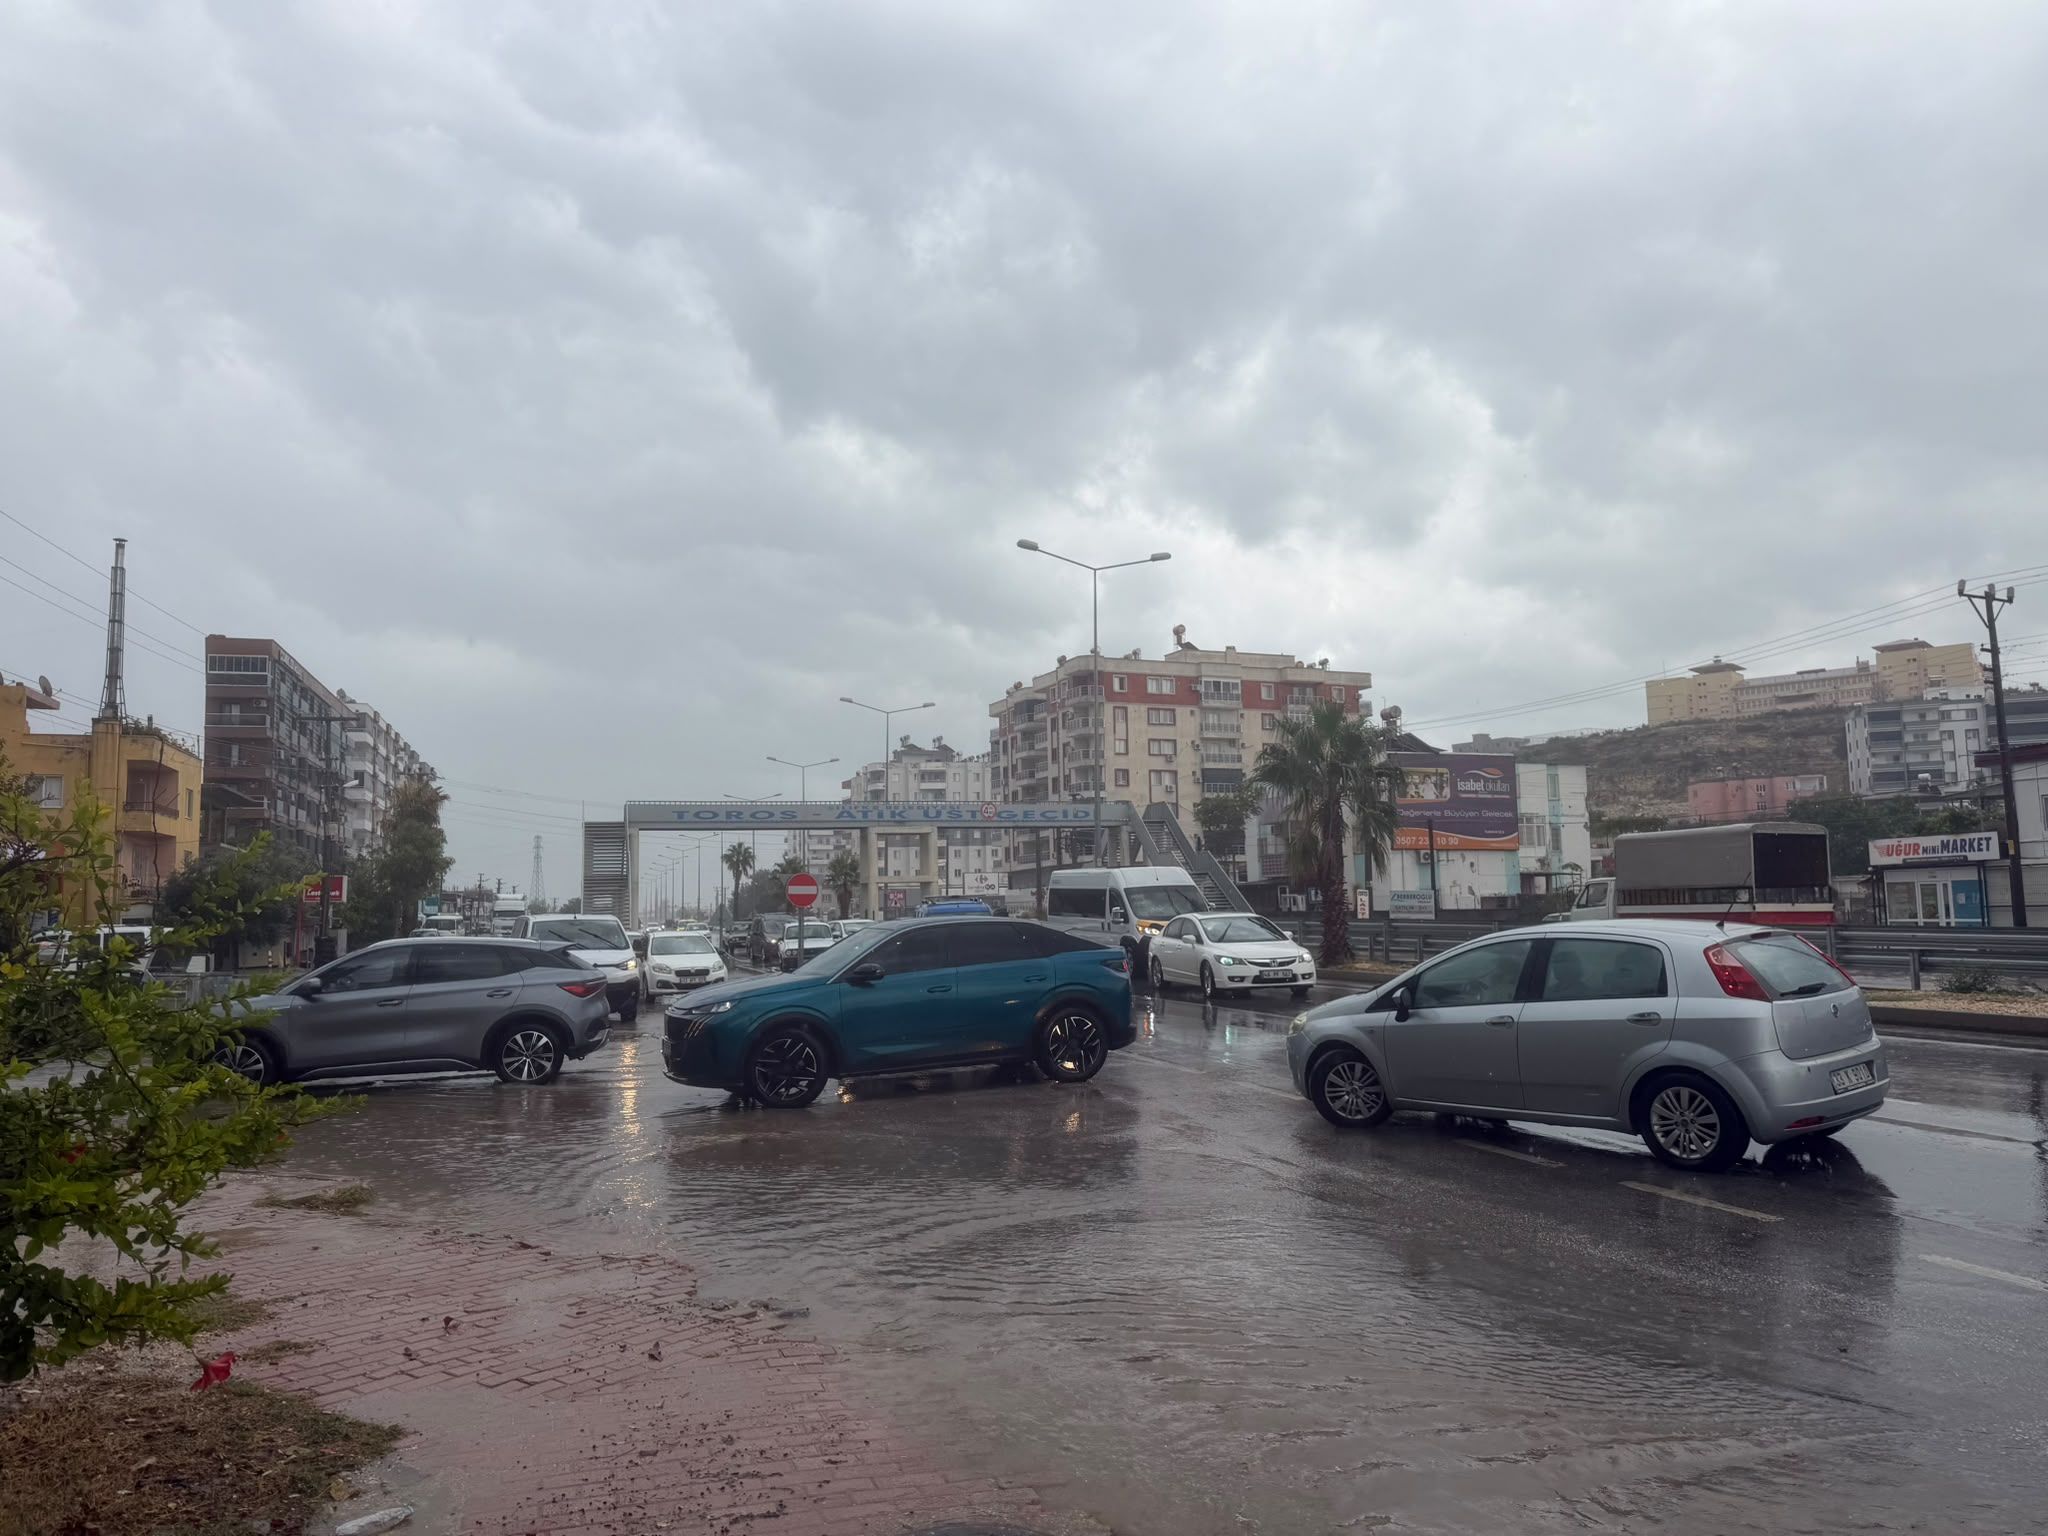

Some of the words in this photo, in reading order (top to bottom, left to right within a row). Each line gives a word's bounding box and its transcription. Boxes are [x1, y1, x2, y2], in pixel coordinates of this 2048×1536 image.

[1457, 778, 1485, 792] isabet
[671, 809, 798, 820] TOROS
[1444, 809, 1480, 818] Büyüyen
[1481, 810, 1514, 818] Gelecek
[1886, 840, 1920, 857] UĞUR
[1940, 836, 1992, 855] MARKET
